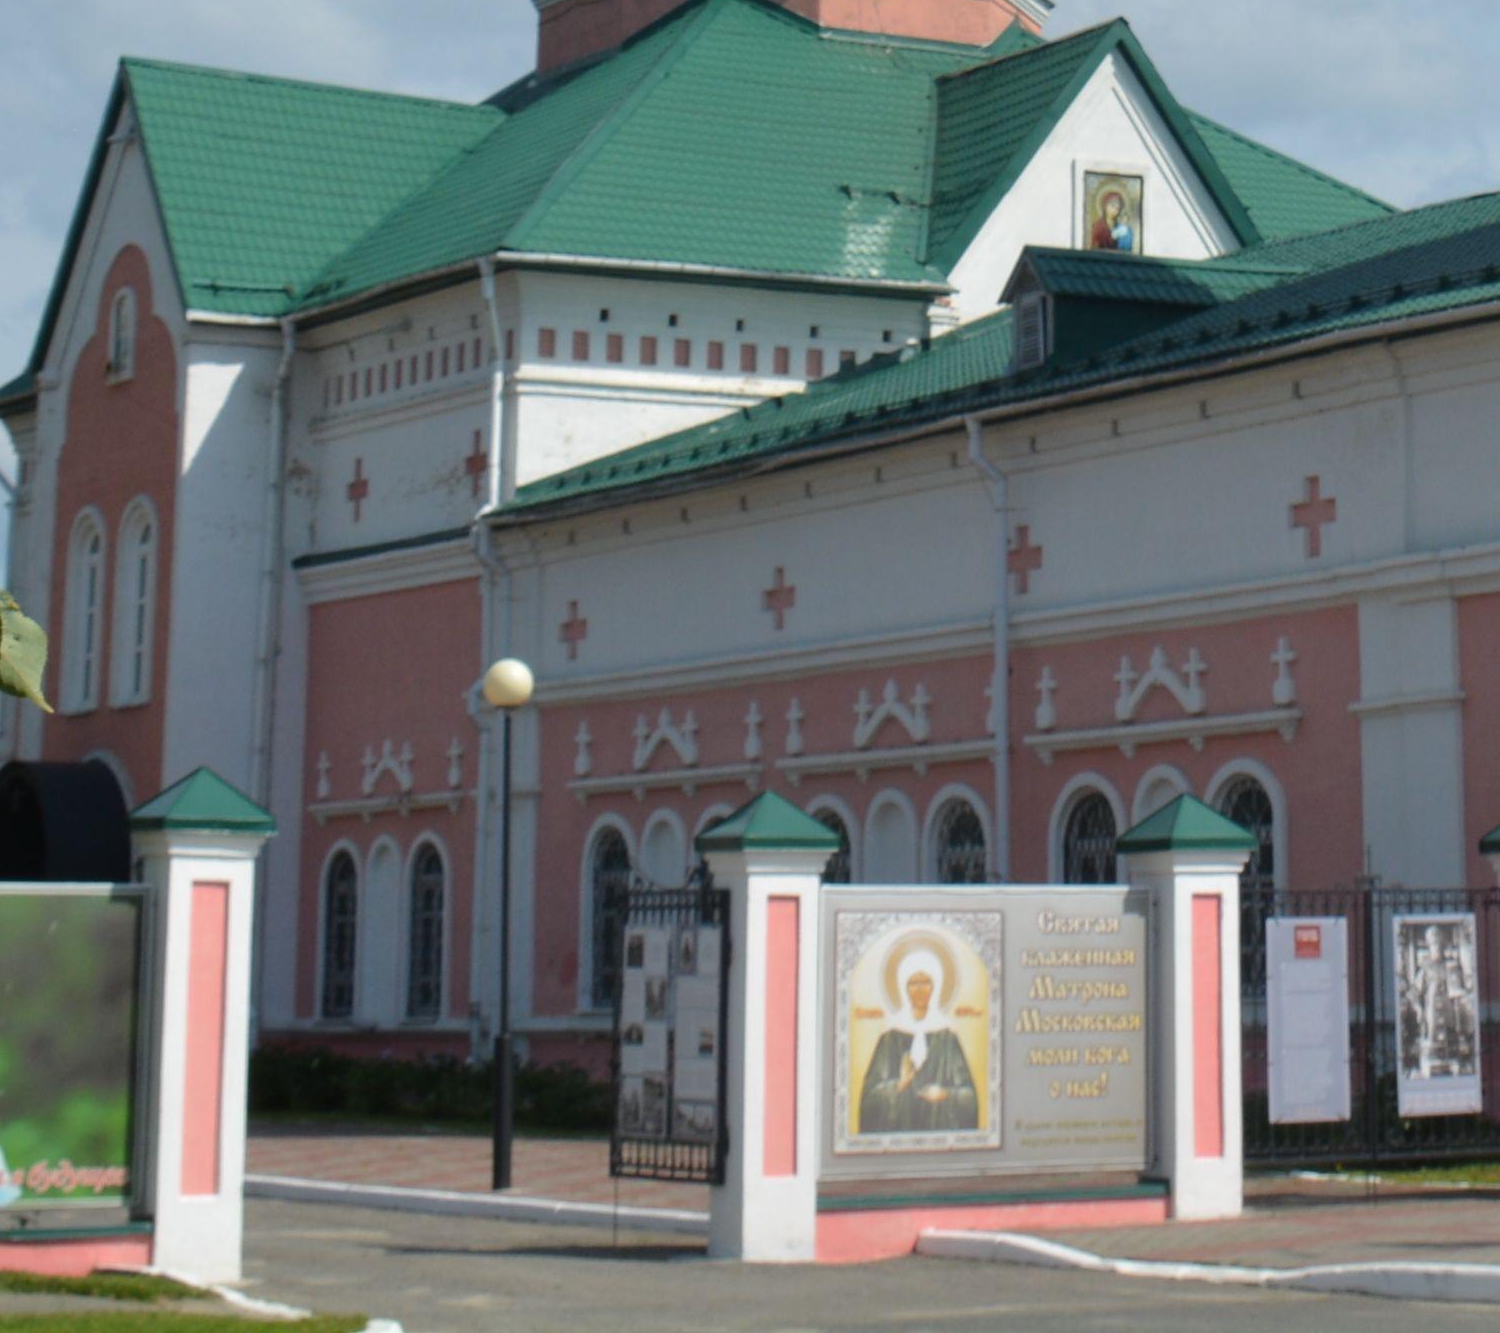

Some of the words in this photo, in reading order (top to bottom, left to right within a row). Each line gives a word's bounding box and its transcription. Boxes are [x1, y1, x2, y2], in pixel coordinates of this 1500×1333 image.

[1038, 910, 1120, 934] Святая
[1028, 975, 1129, 1004] Матрона
[1013, 1007, 1141, 1032] Московская
